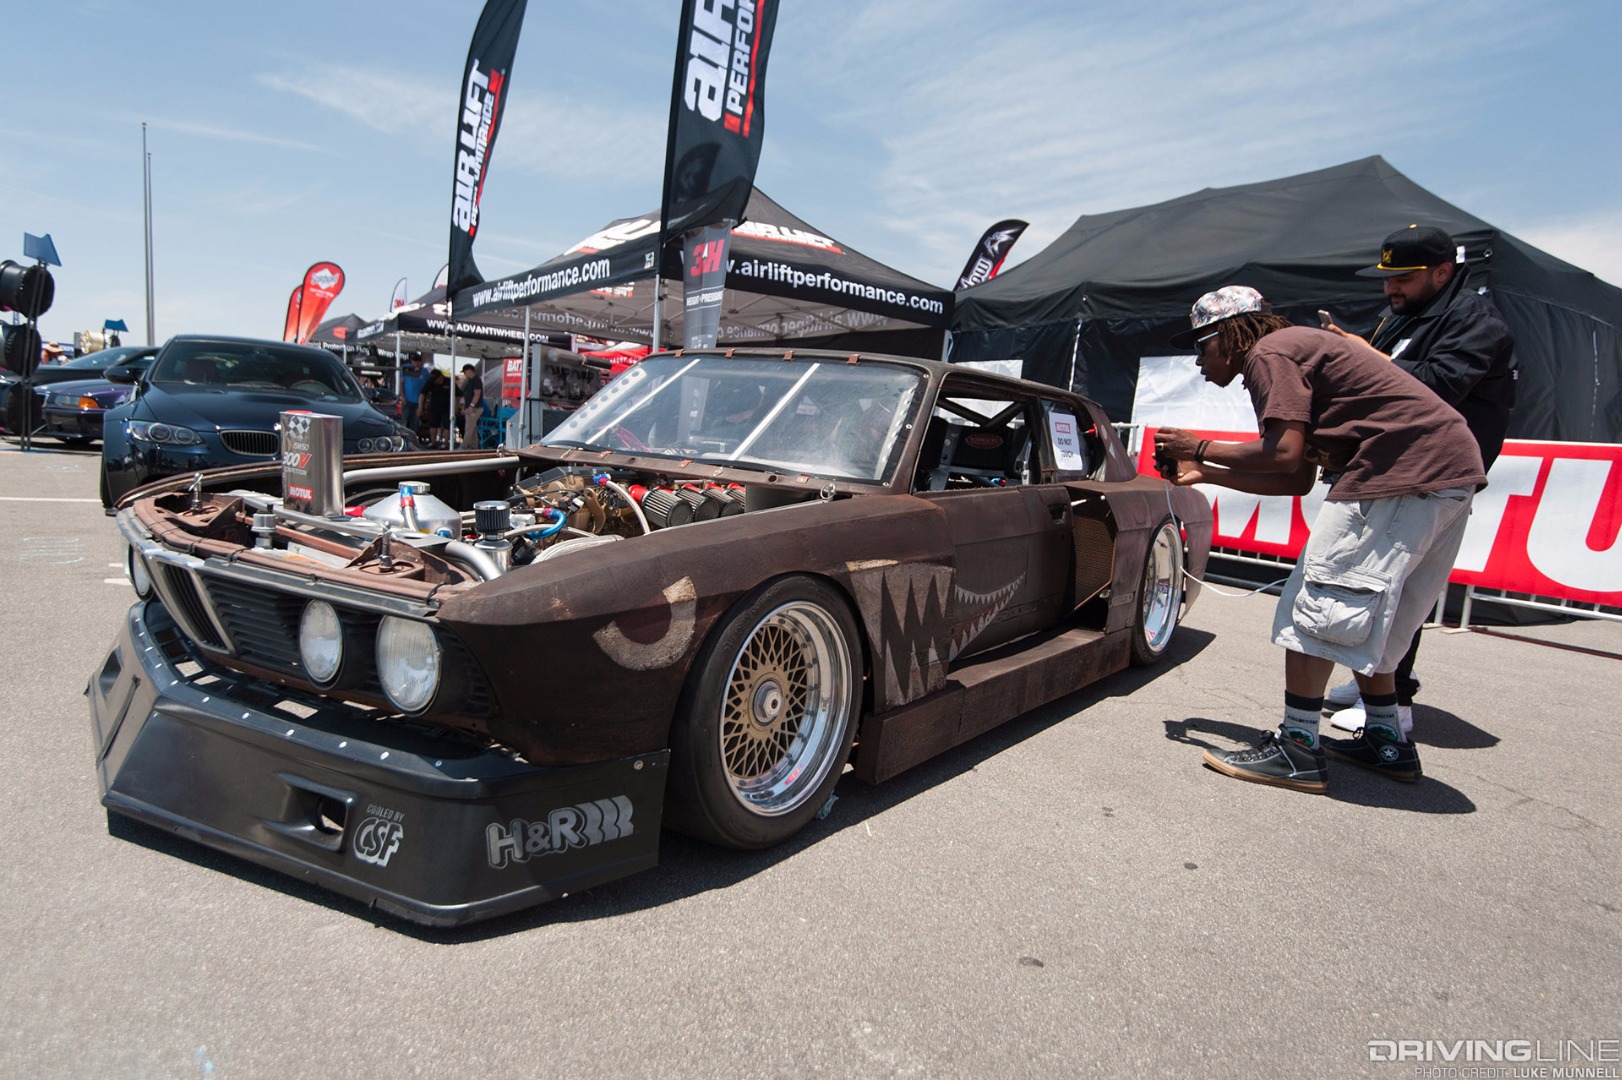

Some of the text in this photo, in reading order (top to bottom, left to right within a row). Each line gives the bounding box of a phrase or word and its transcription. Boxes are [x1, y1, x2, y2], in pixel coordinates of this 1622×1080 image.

[472, 257, 611, 308] www.airliftperformance.com
[289, 486, 312, 500] MOTUL
[366, 803, 406, 822] COOLED BY
